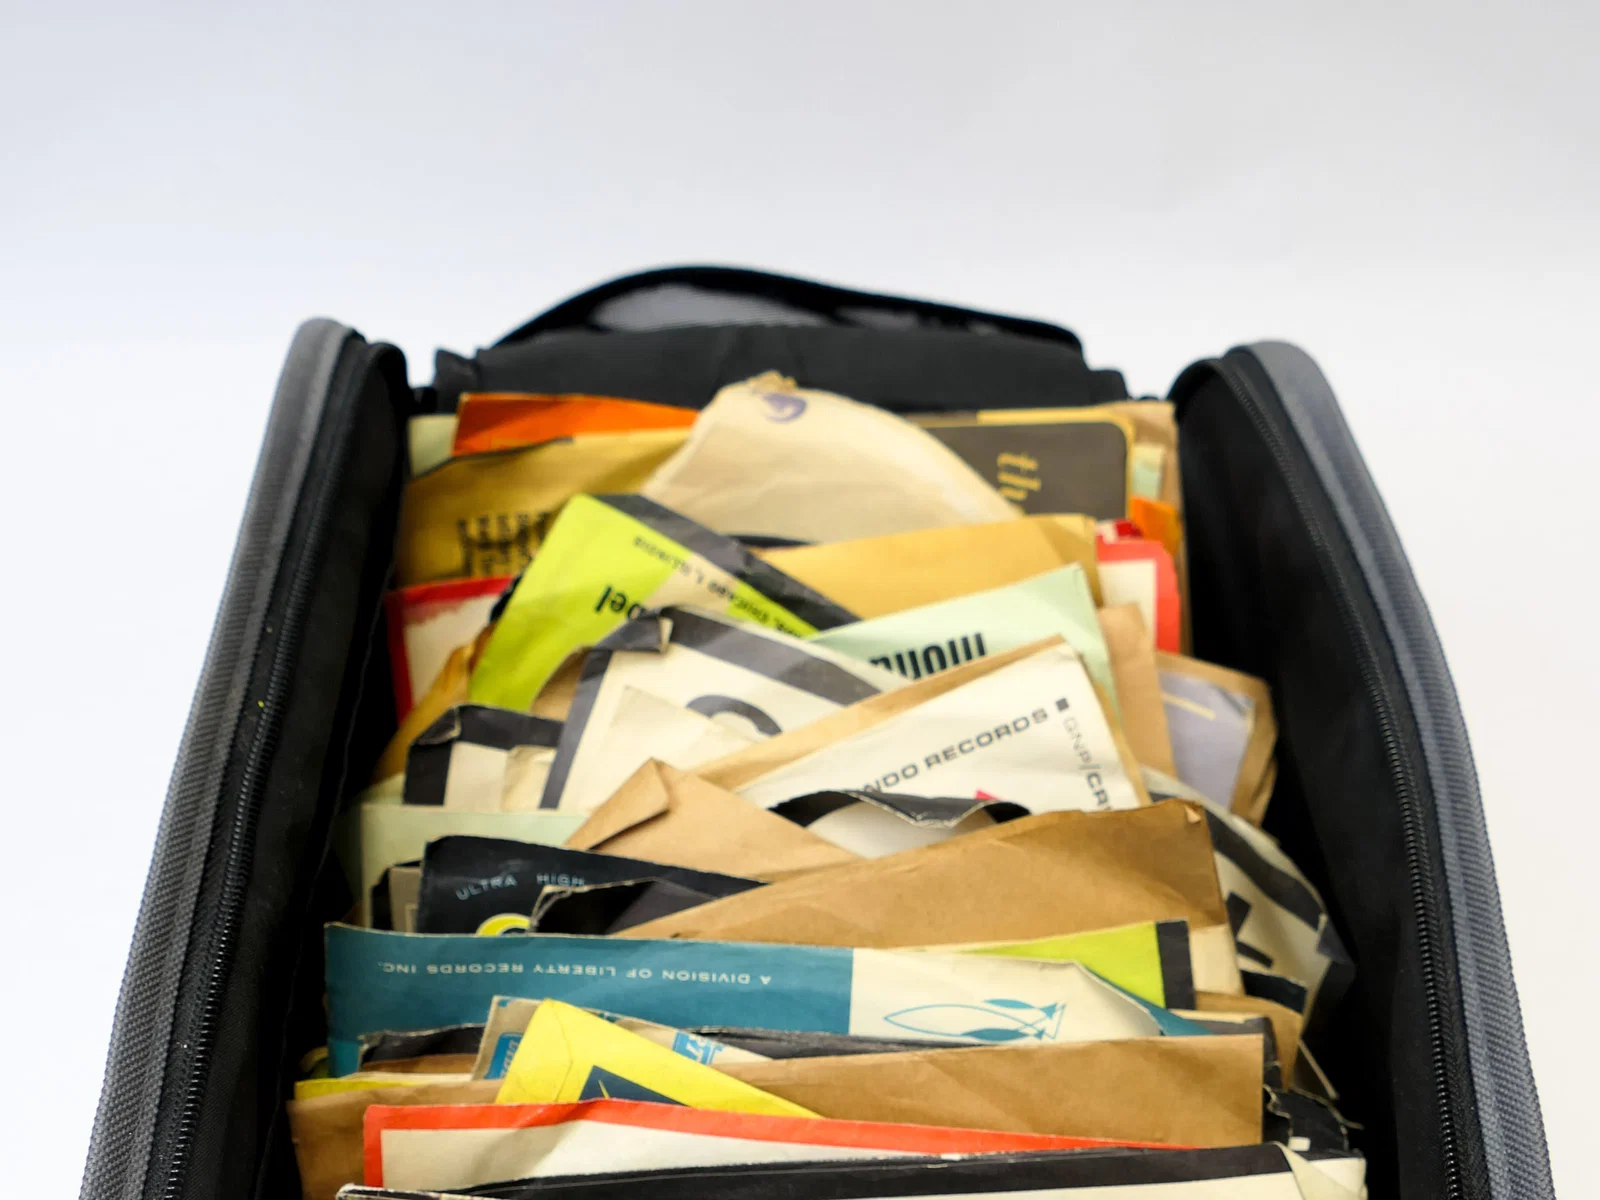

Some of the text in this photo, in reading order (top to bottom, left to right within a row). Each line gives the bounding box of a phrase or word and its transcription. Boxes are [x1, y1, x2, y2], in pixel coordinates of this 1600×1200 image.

[923, 708, 1049, 769] RECORDS
[1063, 717, 1112, 811] GNP/CR
[455, 872, 586, 901] ULTRA HIGH
[426, 962, 524, 975] RECORDS
[533, 963, 617, 977] LIBERTY
[625, 967, 653, 980] OF
[661, 968, 751, 985] DIVISION
[759, 975, 773, 986] A
